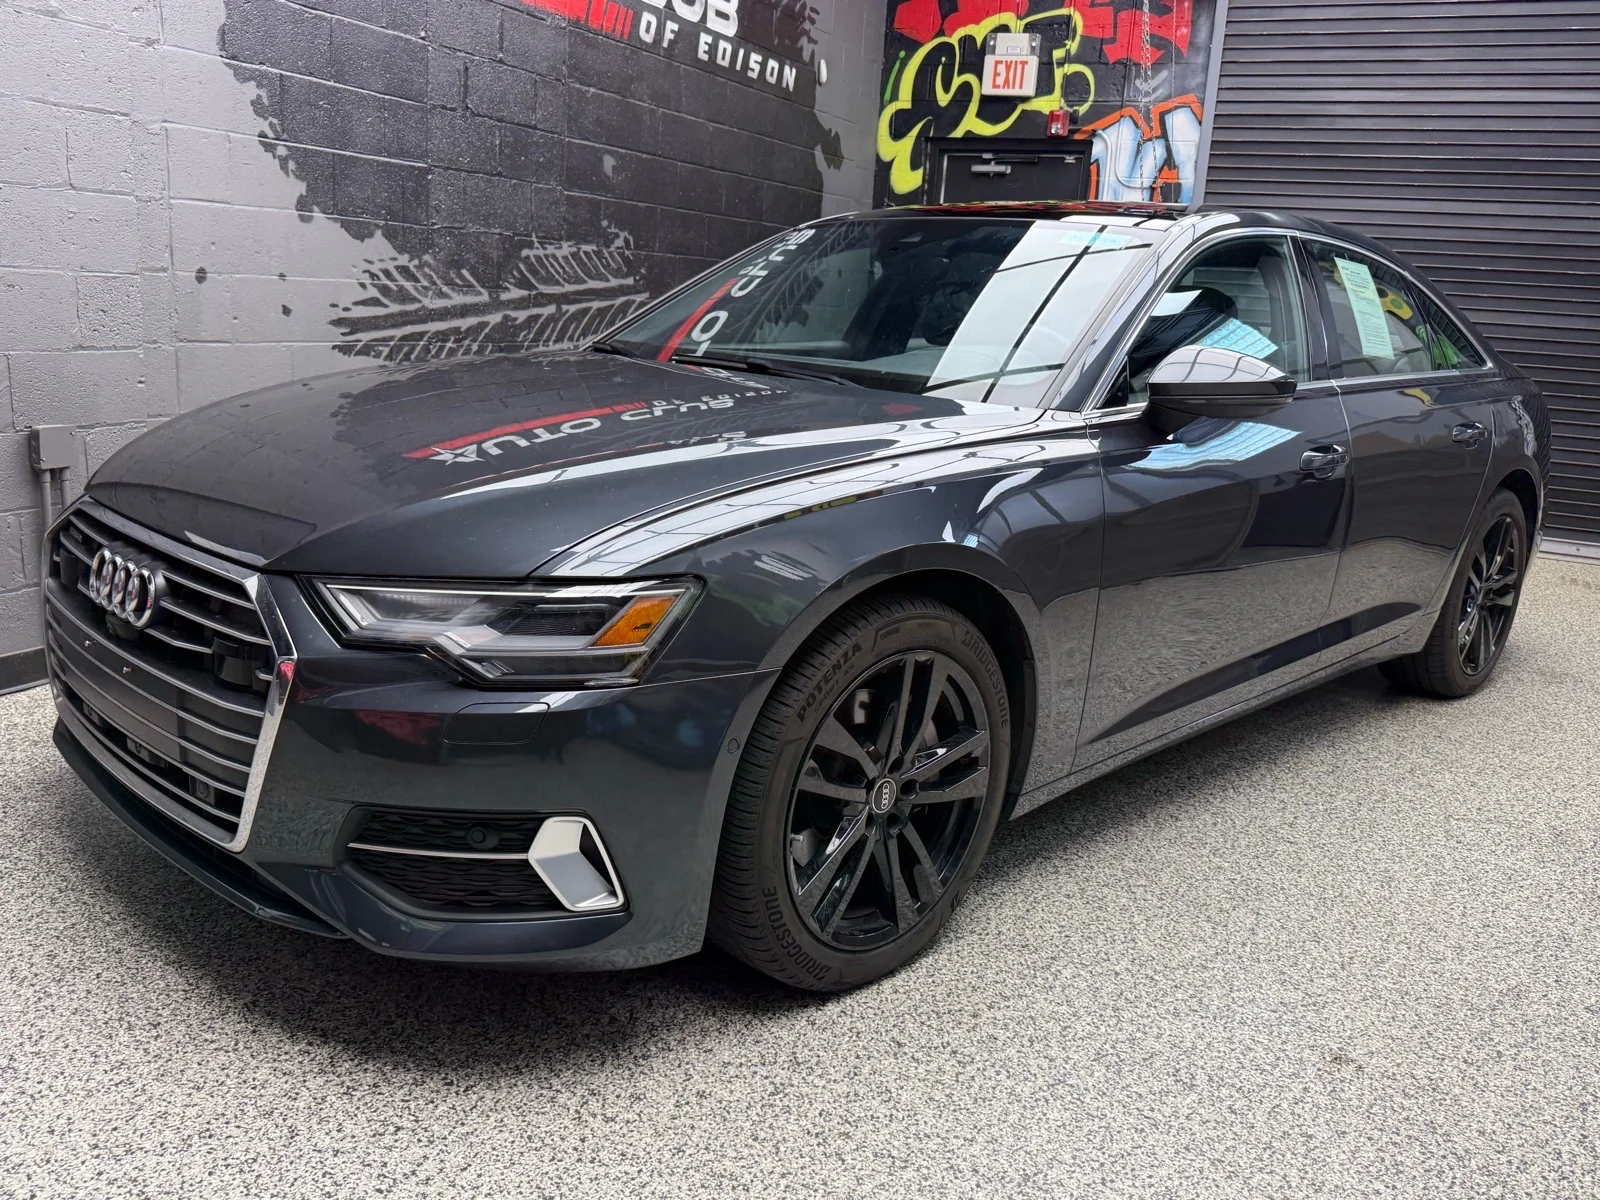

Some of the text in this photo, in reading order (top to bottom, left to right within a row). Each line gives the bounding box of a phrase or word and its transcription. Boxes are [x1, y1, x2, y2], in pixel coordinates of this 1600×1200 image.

[639, 11, 797, 92] OF EDISON
[991, 60, 1028, 90] EXIT
[797, 642, 863, 722] POTENZA
[961, 629, 1010, 730] BRIDGESTONE
[762, 886, 832, 982] BRIDGESTONE
